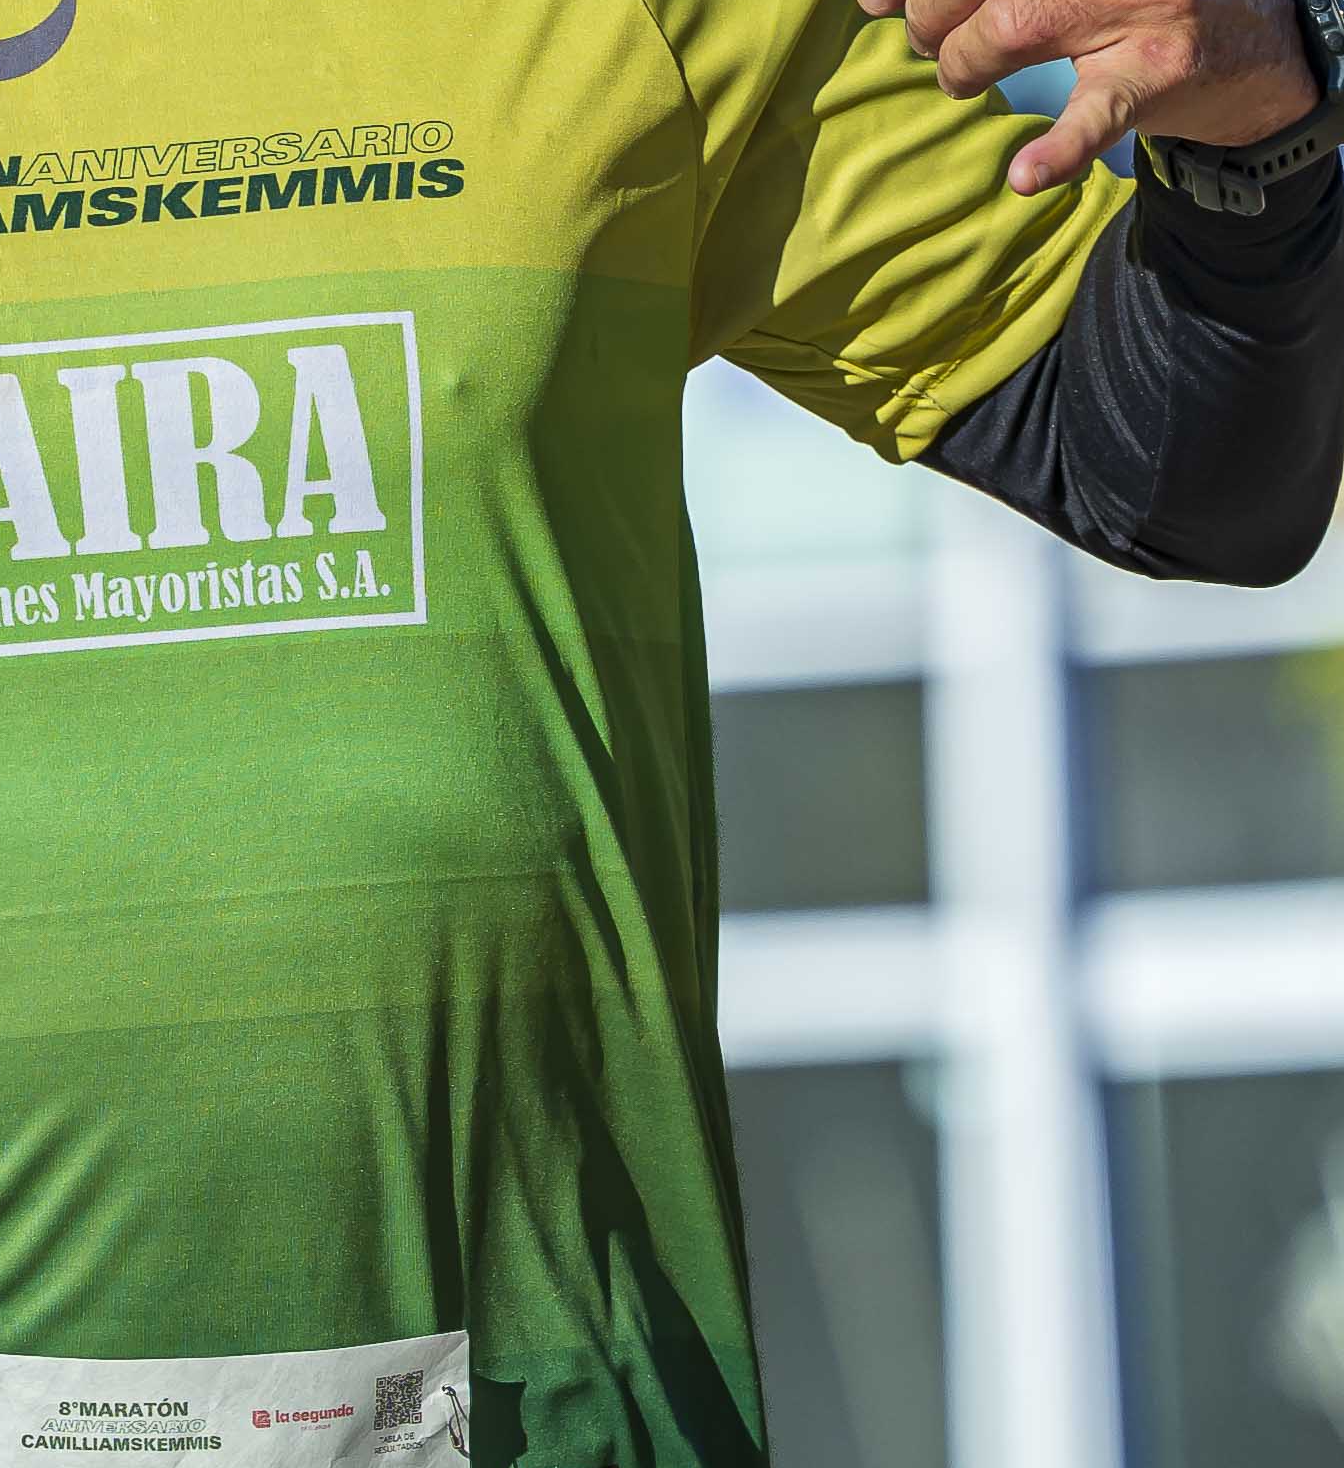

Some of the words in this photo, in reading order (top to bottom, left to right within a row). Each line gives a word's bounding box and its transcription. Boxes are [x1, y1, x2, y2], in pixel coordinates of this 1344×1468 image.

[72, 559, 303, 624] Mayoristas
[318, 551, 392, 601] S.A.
[275, 1409, 290, 1423] la
[292, 1404, 355, 1426] segunda
[41, 1418, 207, 1434] ANIVERSARIO
[21, 1434, 223, 1452] CAWILLIAMSKEMMIS
